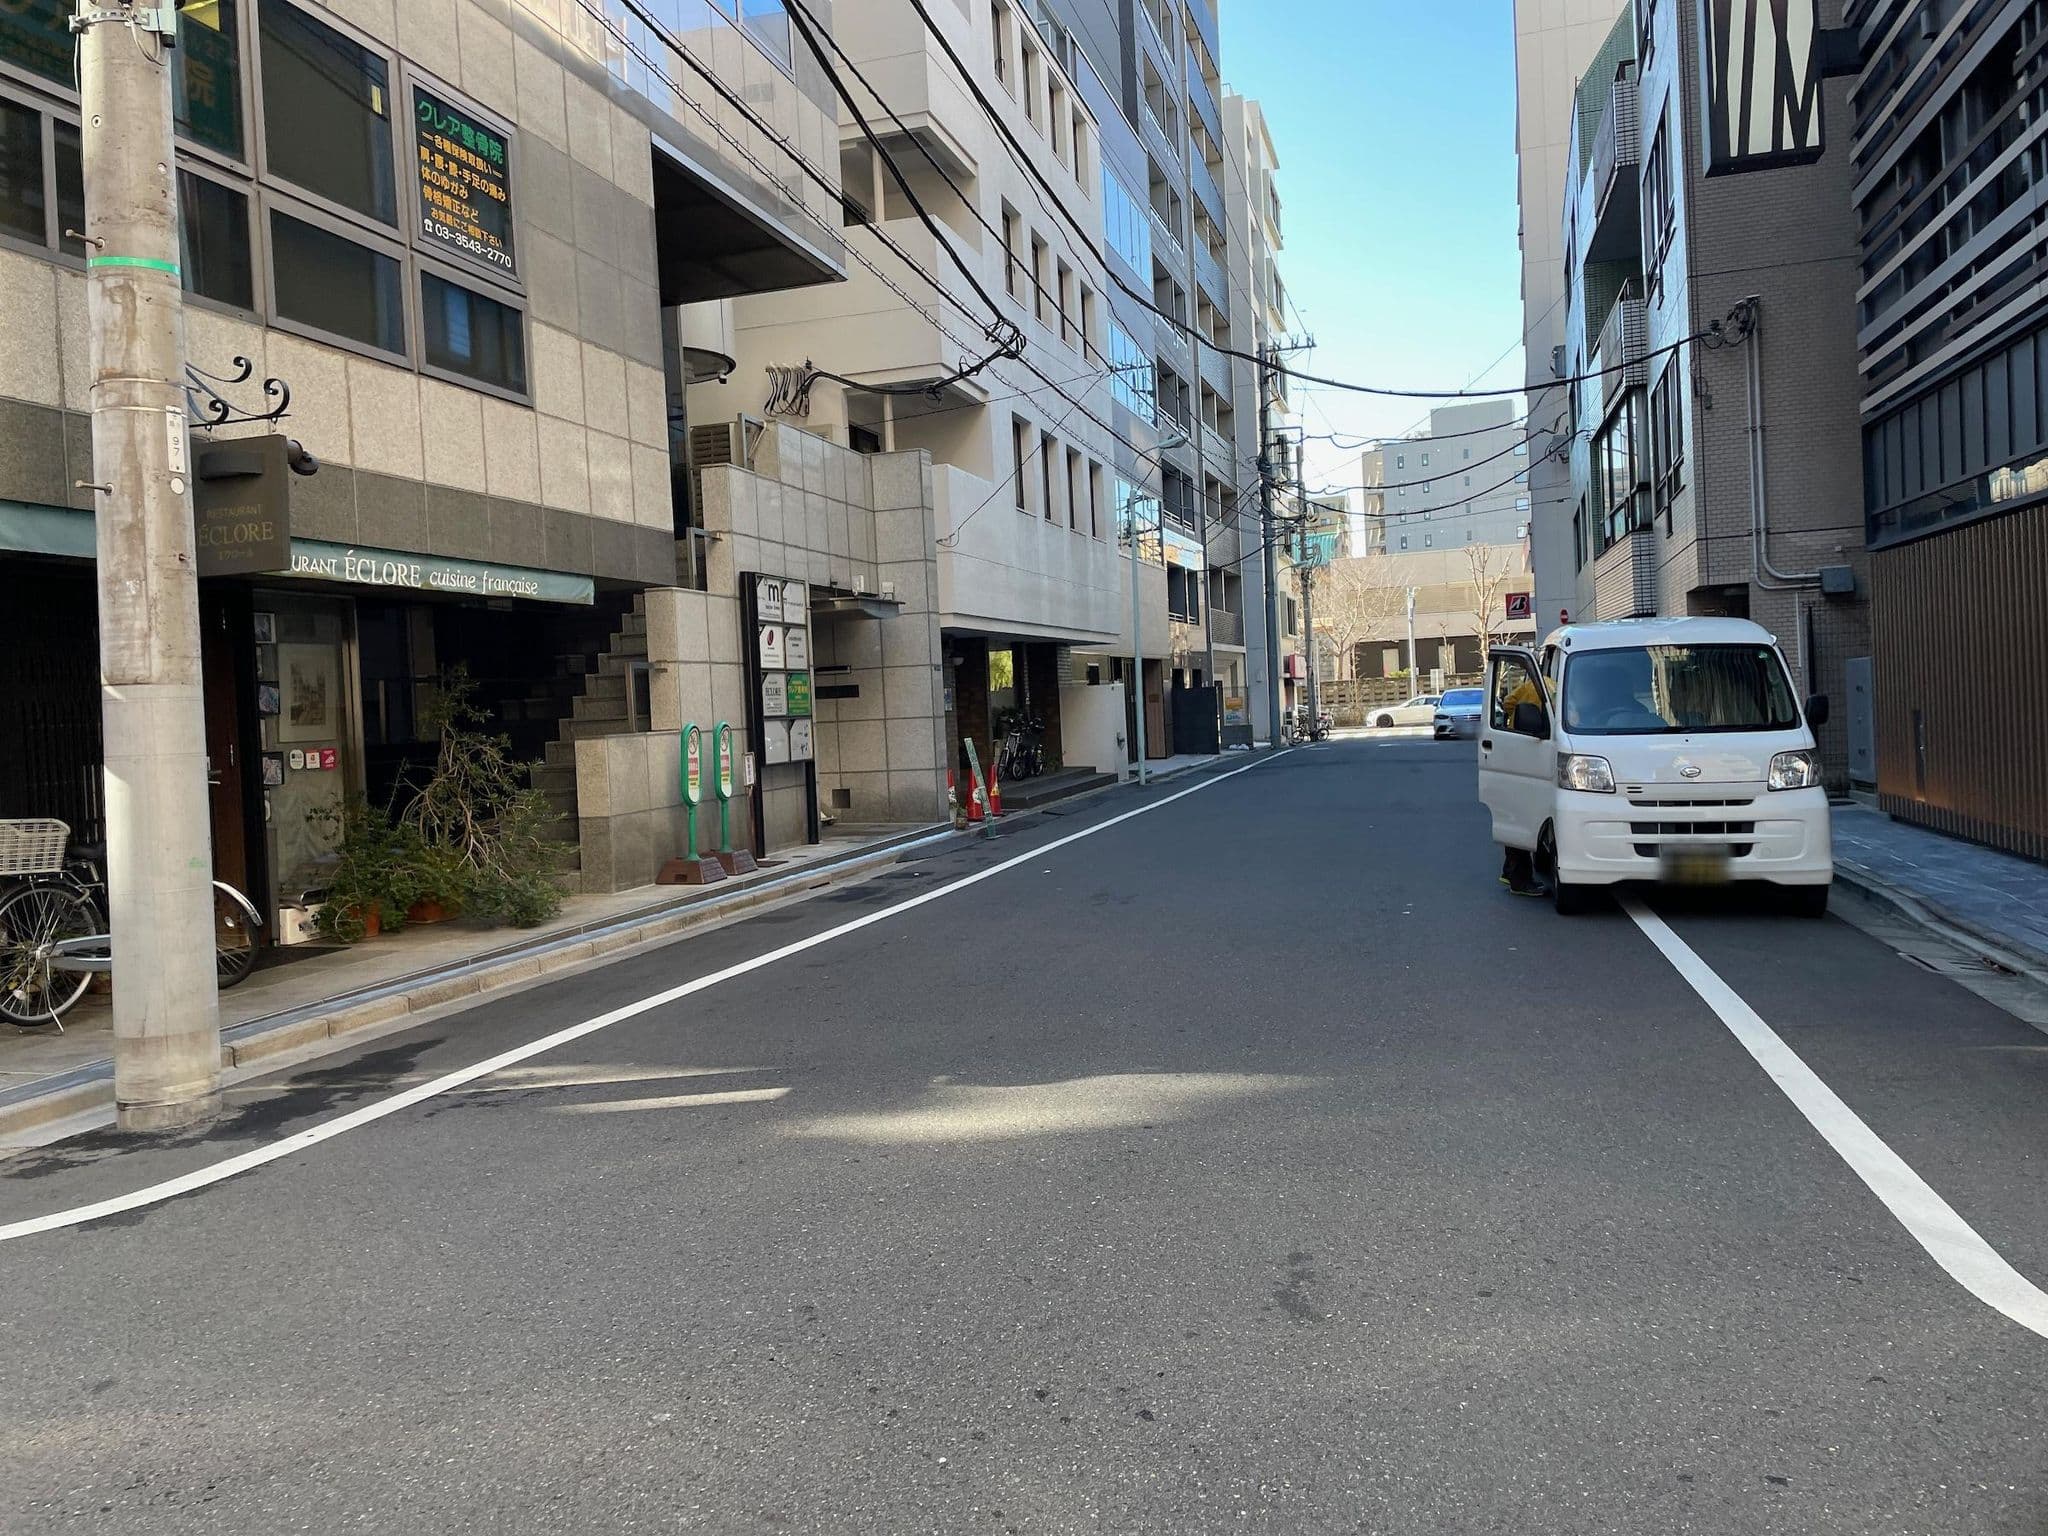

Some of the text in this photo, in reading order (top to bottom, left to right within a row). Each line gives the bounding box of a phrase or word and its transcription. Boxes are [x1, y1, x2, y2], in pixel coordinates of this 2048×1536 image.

[418, 100, 503, 165] クレア整骨院
[421, 164, 469, 200] 体のゆがみ
[435, 223, 512, 268] 03-3543-2770
[199, 521, 274, 545] ÉCLORE
[290, 550, 538, 597] URANT ÉCLORE cuisine française
